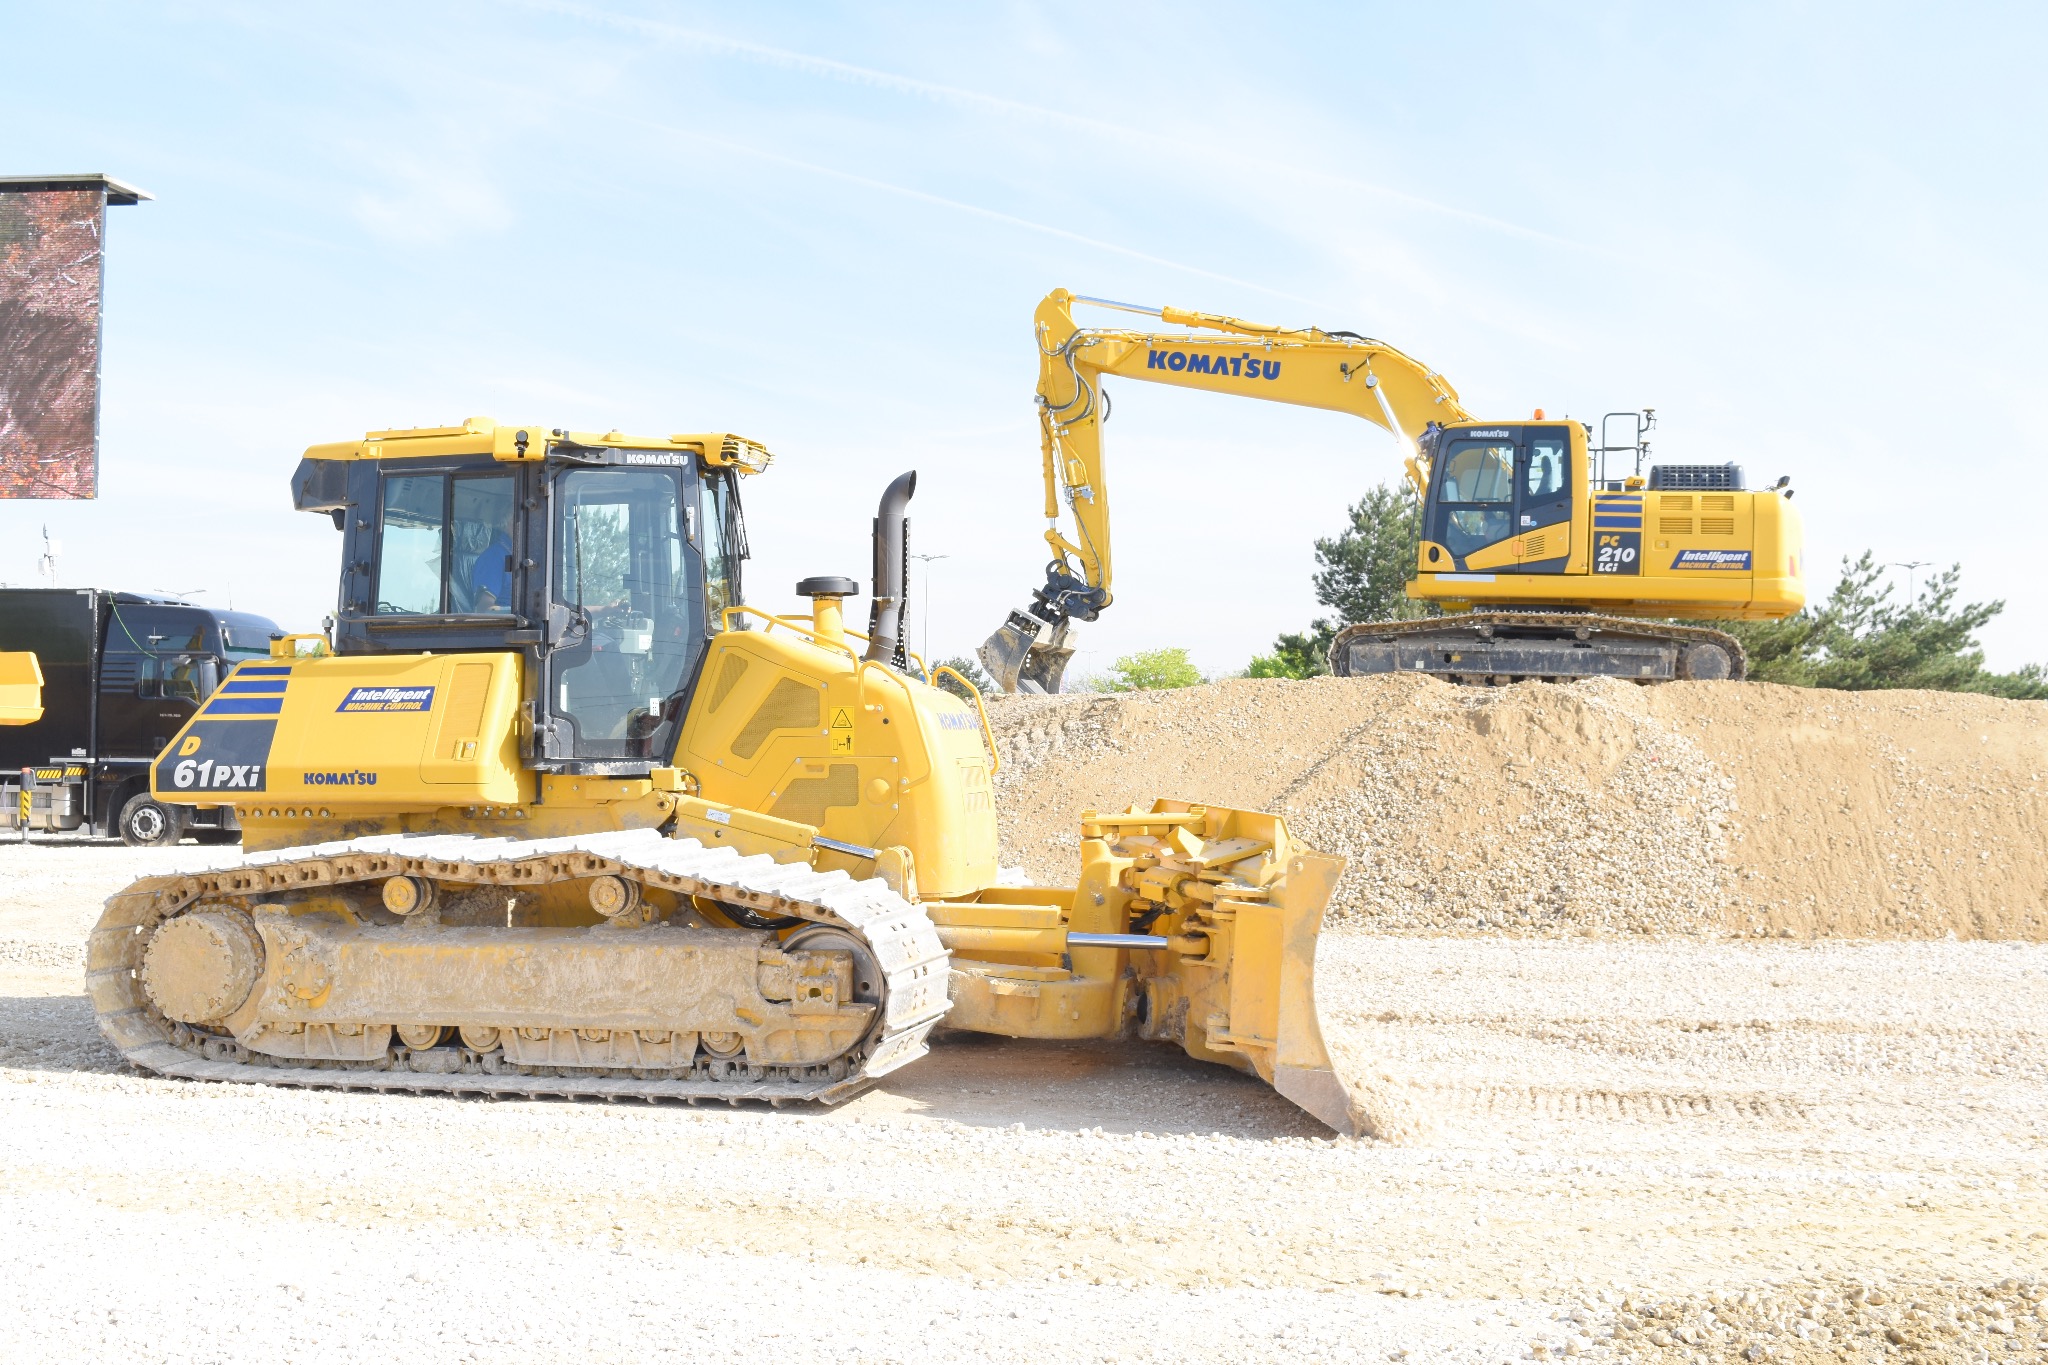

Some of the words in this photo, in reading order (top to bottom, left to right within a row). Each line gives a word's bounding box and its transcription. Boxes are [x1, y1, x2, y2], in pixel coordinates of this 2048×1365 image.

[1147, 350, 1281, 380] KOMATSU
[1470, 429, 1509, 438] KOMATSU
[626, 452, 689, 466] KOMATSU
[1599, 535, 1620, 547] PC
[1597, 547, 1636, 563] 210
[343, 702, 385, 711] MACHINE
[383, 701, 423, 710] CONTROL
[178, 736, 202, 756] D
[303, 769, 377, 785] KOMATSU
